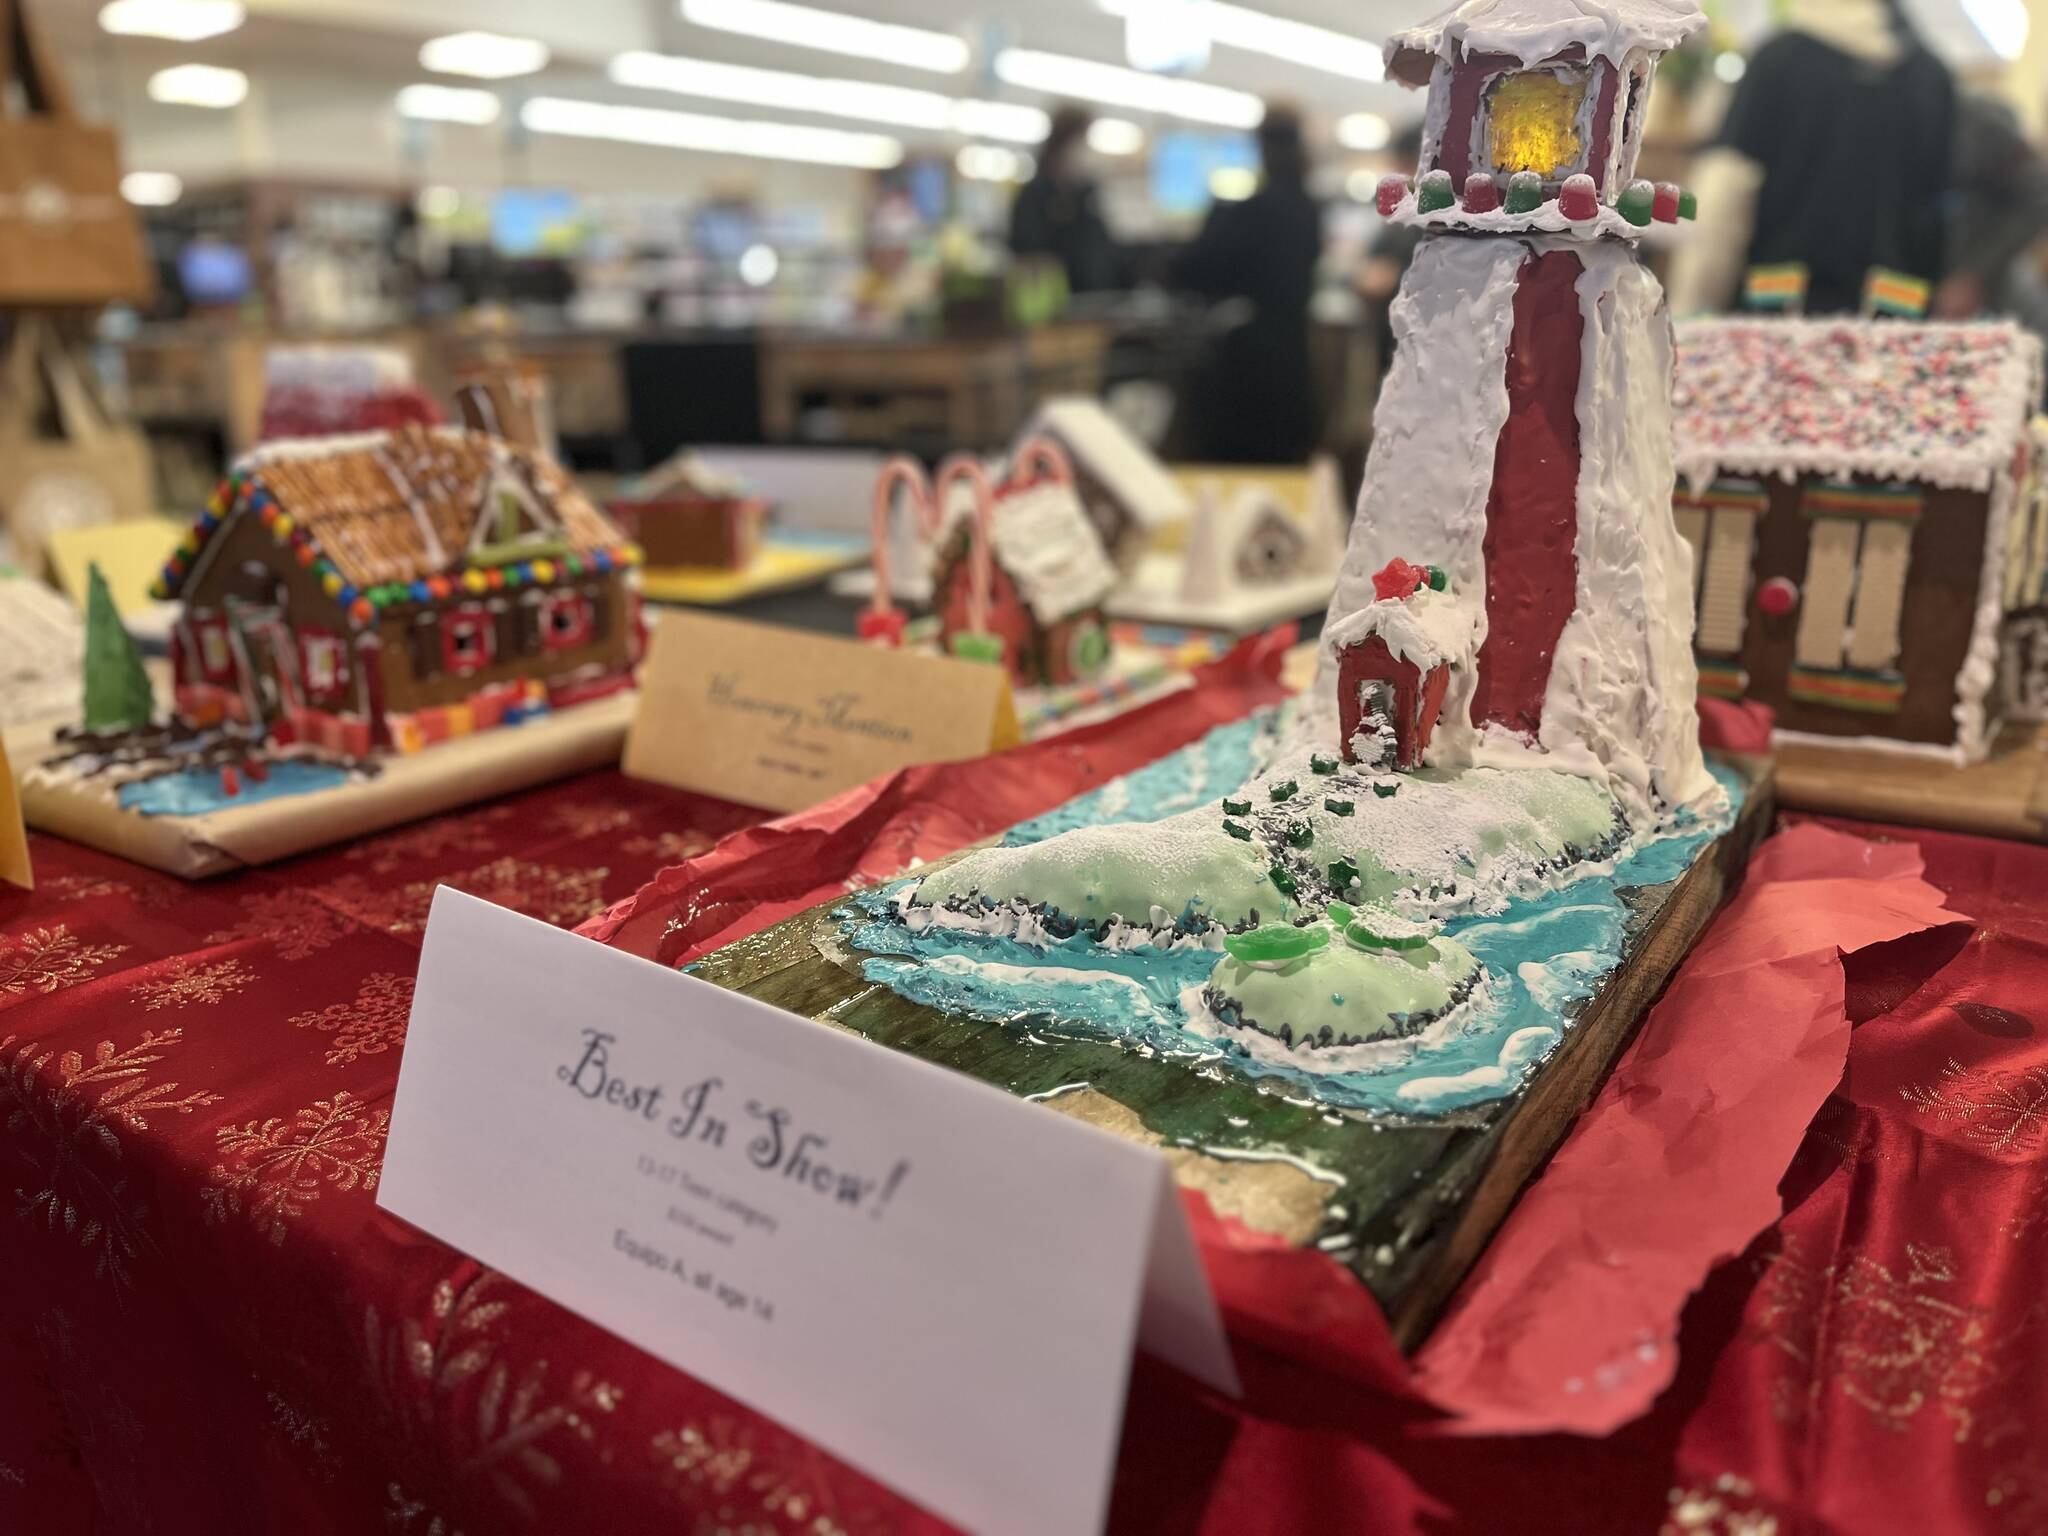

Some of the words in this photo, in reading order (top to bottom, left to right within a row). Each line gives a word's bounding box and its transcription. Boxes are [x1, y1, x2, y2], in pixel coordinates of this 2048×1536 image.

[557, 1028, 661, 1121] Best
[668, 1077, 727, 1148] In
[746, 1100, 911, 1222] Show!
[694, 1272, 713, 1291] all
[717, 1283, 747, 1311] age
